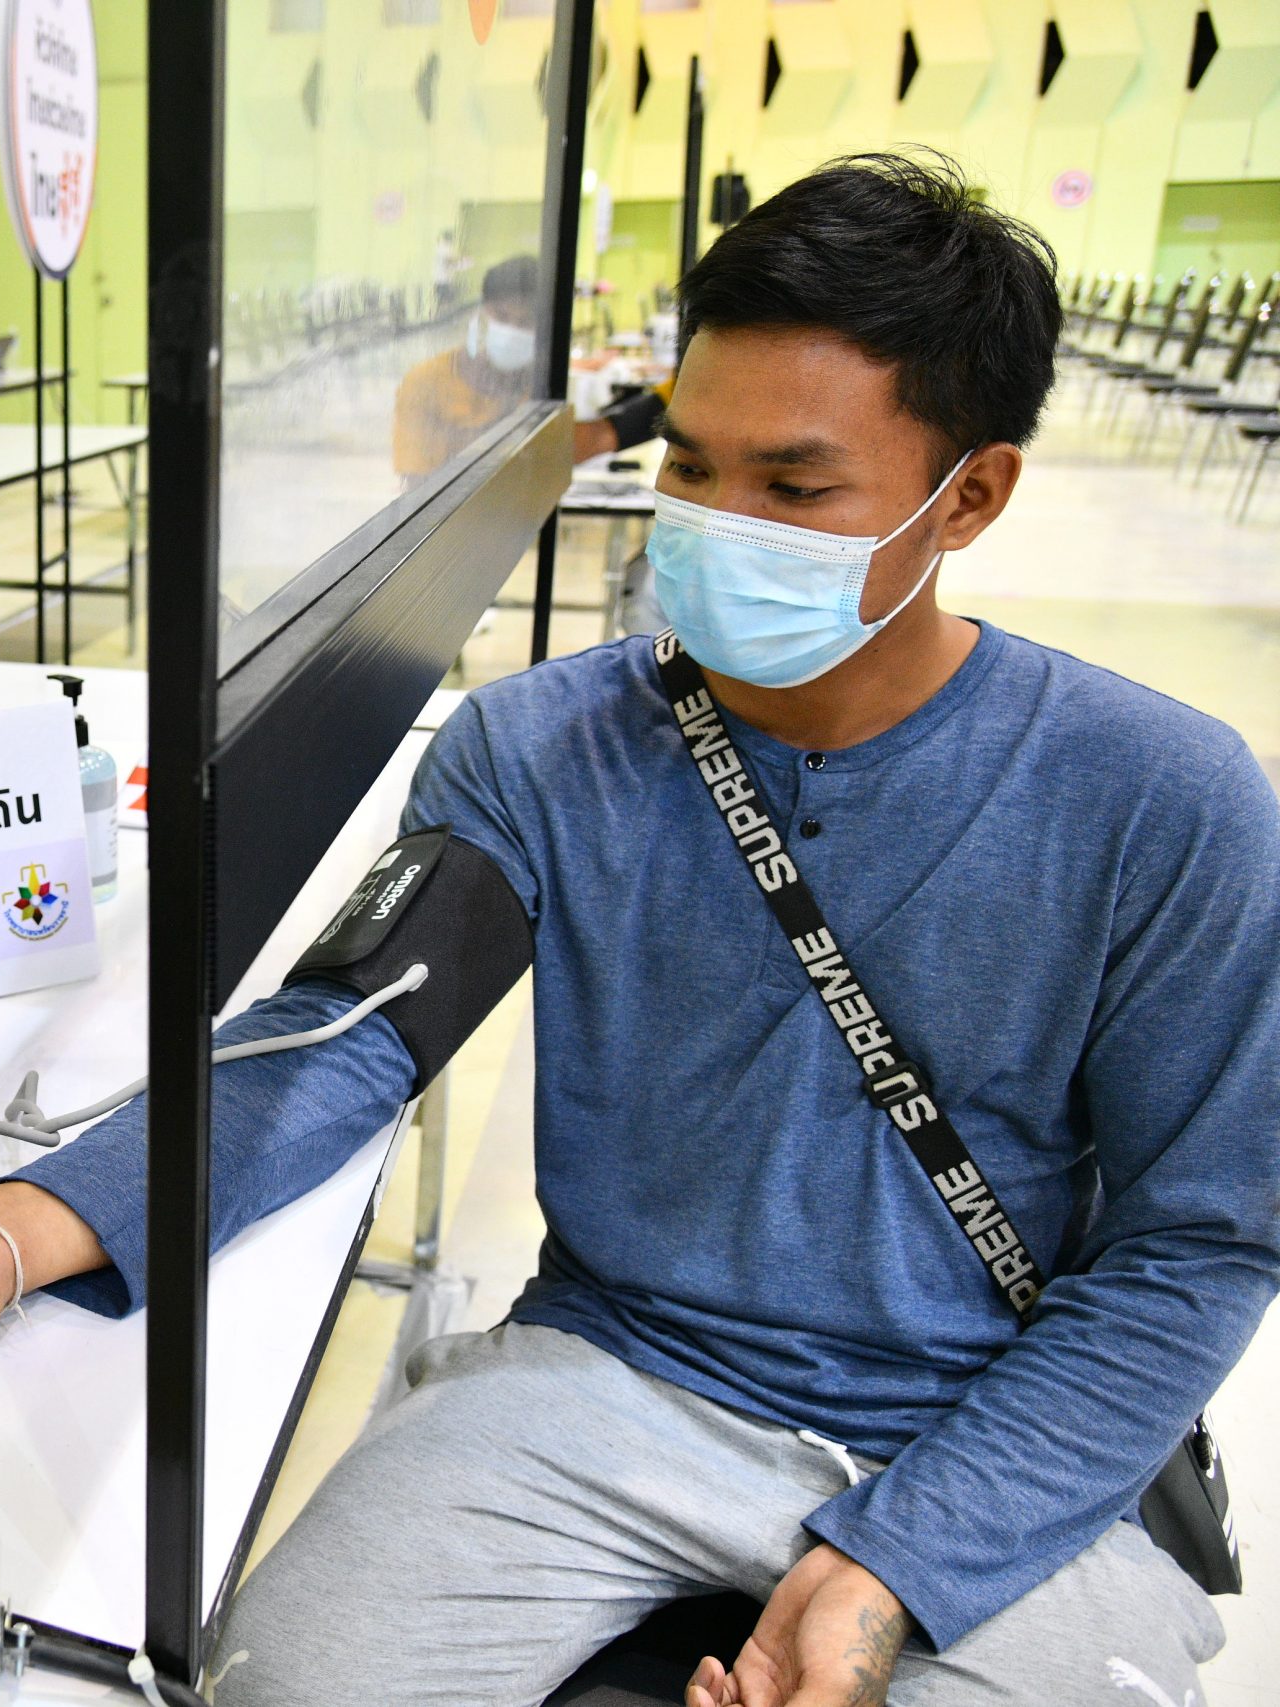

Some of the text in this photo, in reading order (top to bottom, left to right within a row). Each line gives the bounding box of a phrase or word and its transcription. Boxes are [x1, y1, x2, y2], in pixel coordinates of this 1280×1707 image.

[673, 687, 798, 892] SUPREME
[792, 926, 938, 1132] SUPREME
[932, 1160, 1042, 1314] PREME
